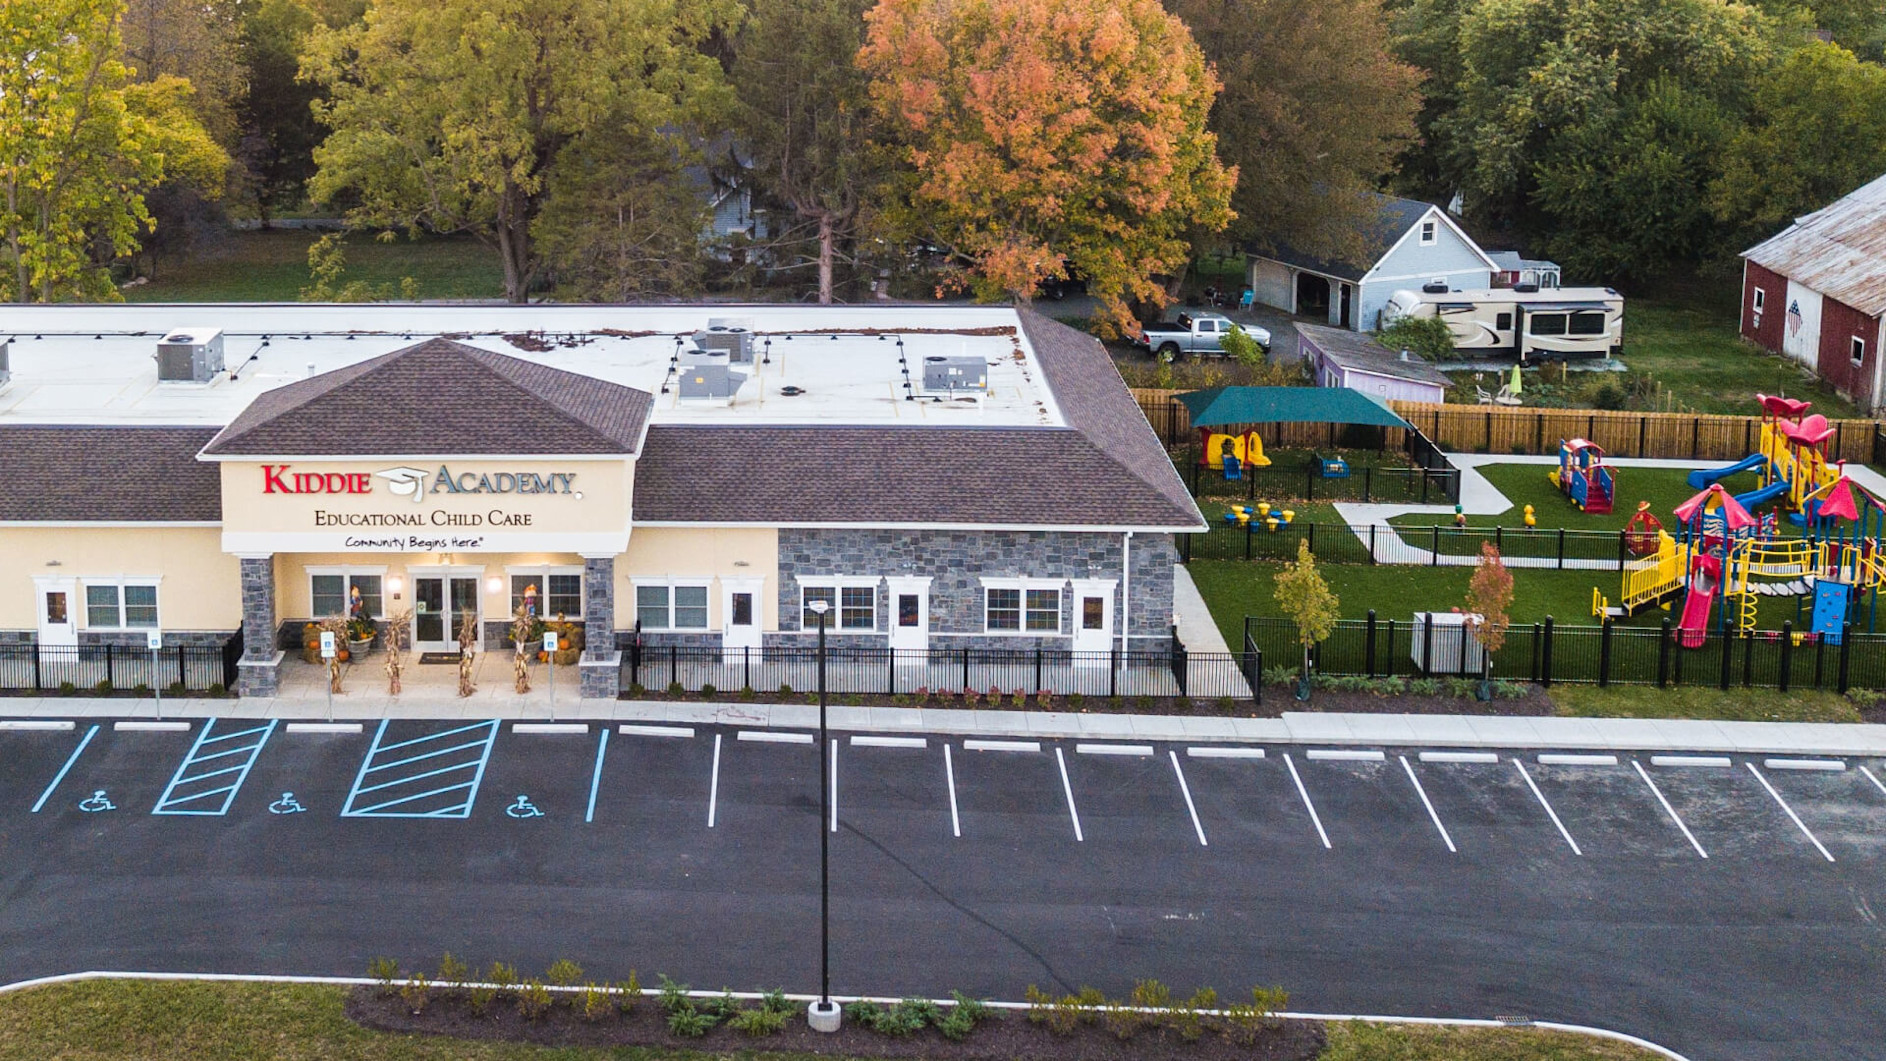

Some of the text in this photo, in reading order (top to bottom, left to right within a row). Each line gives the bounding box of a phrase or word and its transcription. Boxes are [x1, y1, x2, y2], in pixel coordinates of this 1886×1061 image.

[260, 464, 373, 494] KIDDIE
[314, 510, 533, 526] EDUCATIONAL CHILD CARE
[345, 536, 405, 551] Community
[409, 536, 447, 551] Begins
